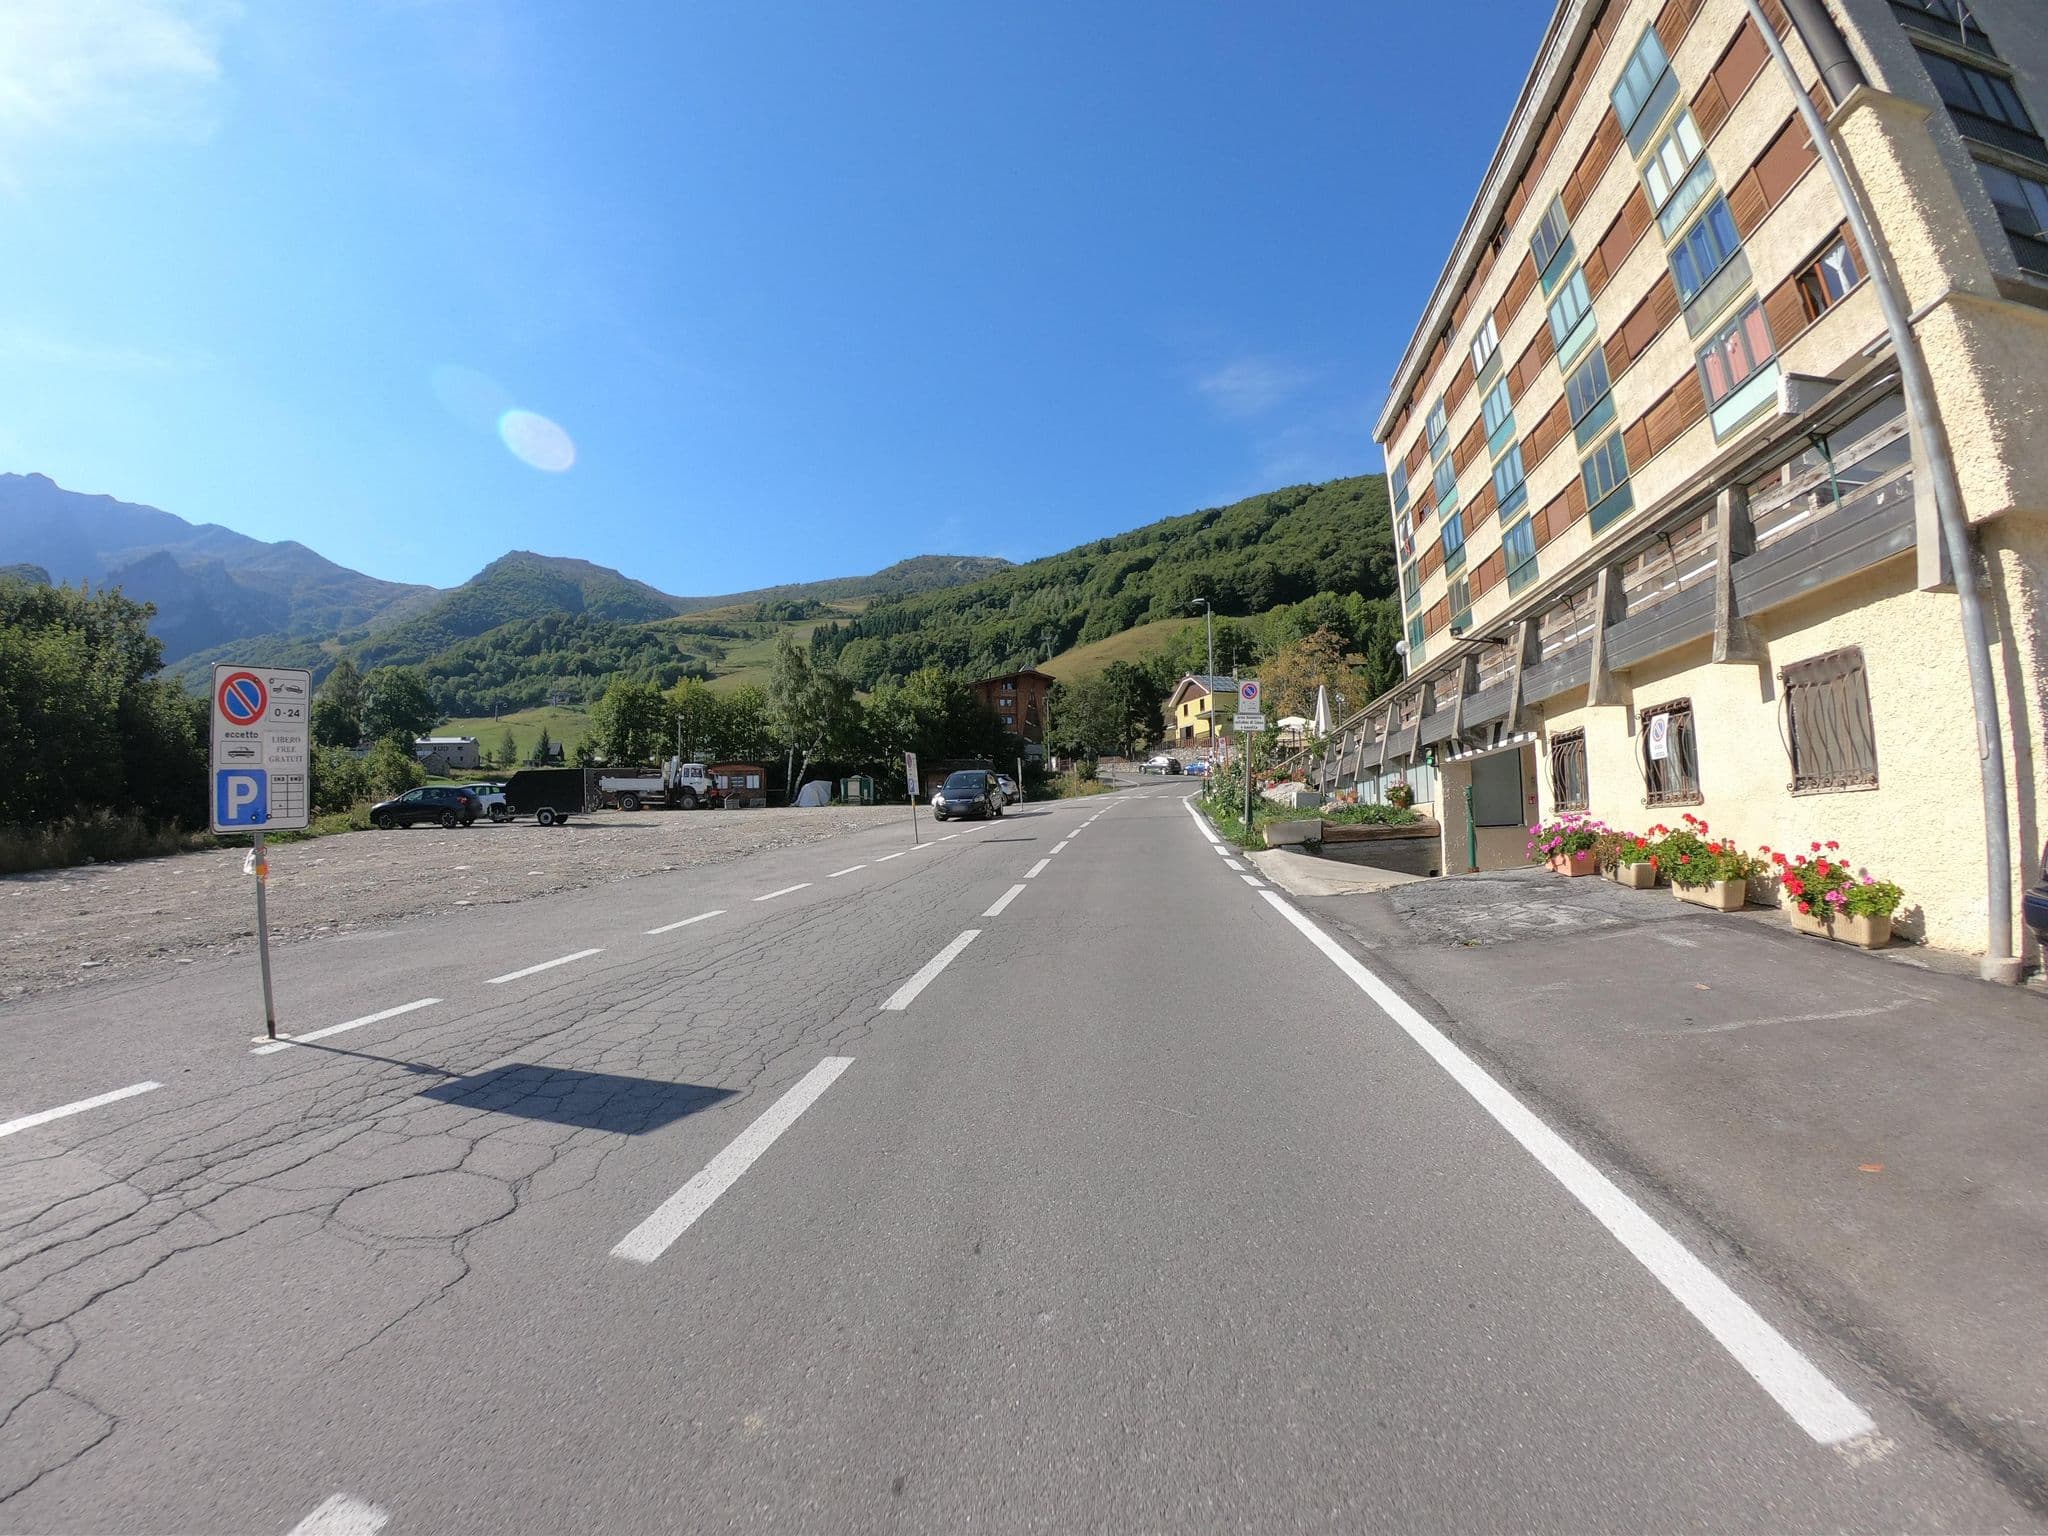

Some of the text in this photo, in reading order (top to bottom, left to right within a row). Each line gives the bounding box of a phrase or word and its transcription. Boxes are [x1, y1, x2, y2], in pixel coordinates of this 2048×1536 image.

[224, 731, 259, 739] eccetto
[271, 736, 301, 744] LIBERO
[269, 755, 303, 763] GRATUIT
[227, 776, 258, 819] P
